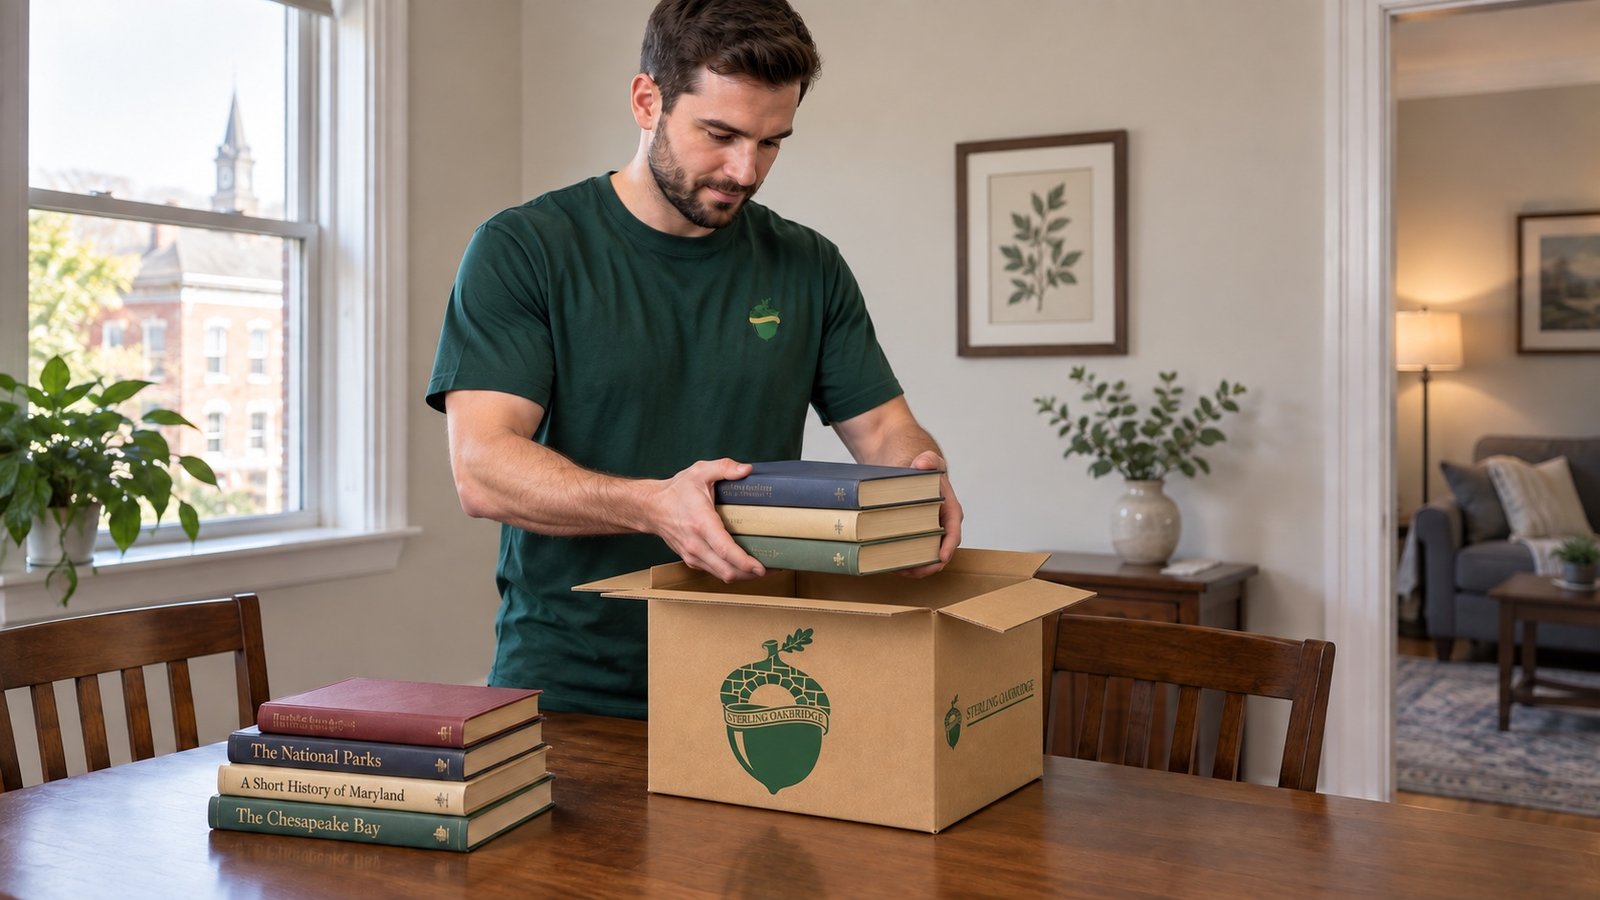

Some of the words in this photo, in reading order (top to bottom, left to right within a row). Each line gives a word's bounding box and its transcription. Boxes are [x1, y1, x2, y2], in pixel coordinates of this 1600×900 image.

[727, 712, 768, 724] STERLING
[769, 709, 824, 723] OAKBRIDGE
[966, 695, 998, 720] STERLING
[251, 743, 278, 760] The
[281, 745, 339, 765] National
[343, 750, 382, 768] Parks
[240, 776, 250, 790] A
[253, 777, 284, 793] Short
[287, 780, 331, 799] History
[333, 784, 346, 797] of
[349, 785, 405, 803] Maryland
[235, 807, 263, 824] The
[266, 811, 350, 833] Chesapeake
[354, 819, 381, 838] Bay
